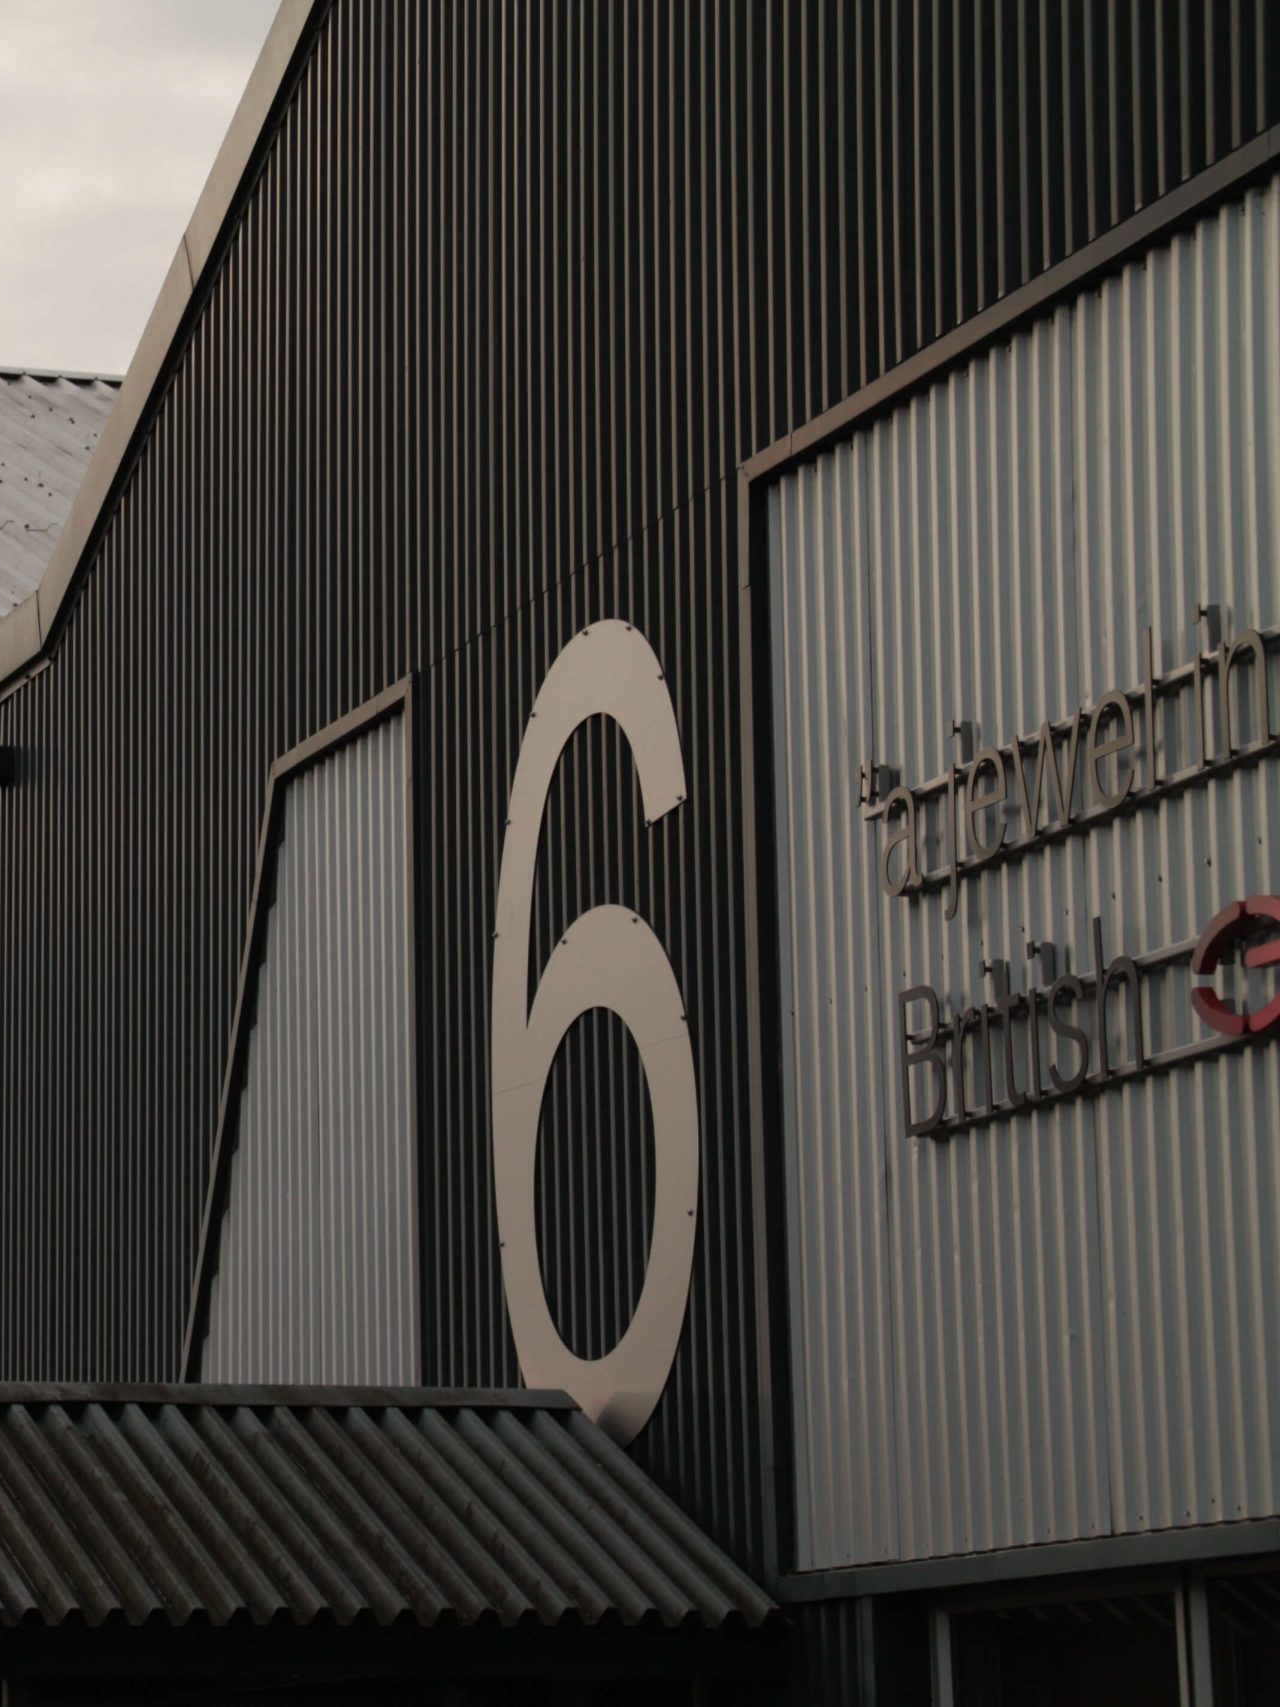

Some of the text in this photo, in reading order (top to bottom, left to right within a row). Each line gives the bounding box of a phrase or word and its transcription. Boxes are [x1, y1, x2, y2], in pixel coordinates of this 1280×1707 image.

[946, 624, 1157, 921] jewel
[1193, 603, 1270, 774] in
[491, 618, 700, 1452] 6
[898, 916, 1144, 1139] British
